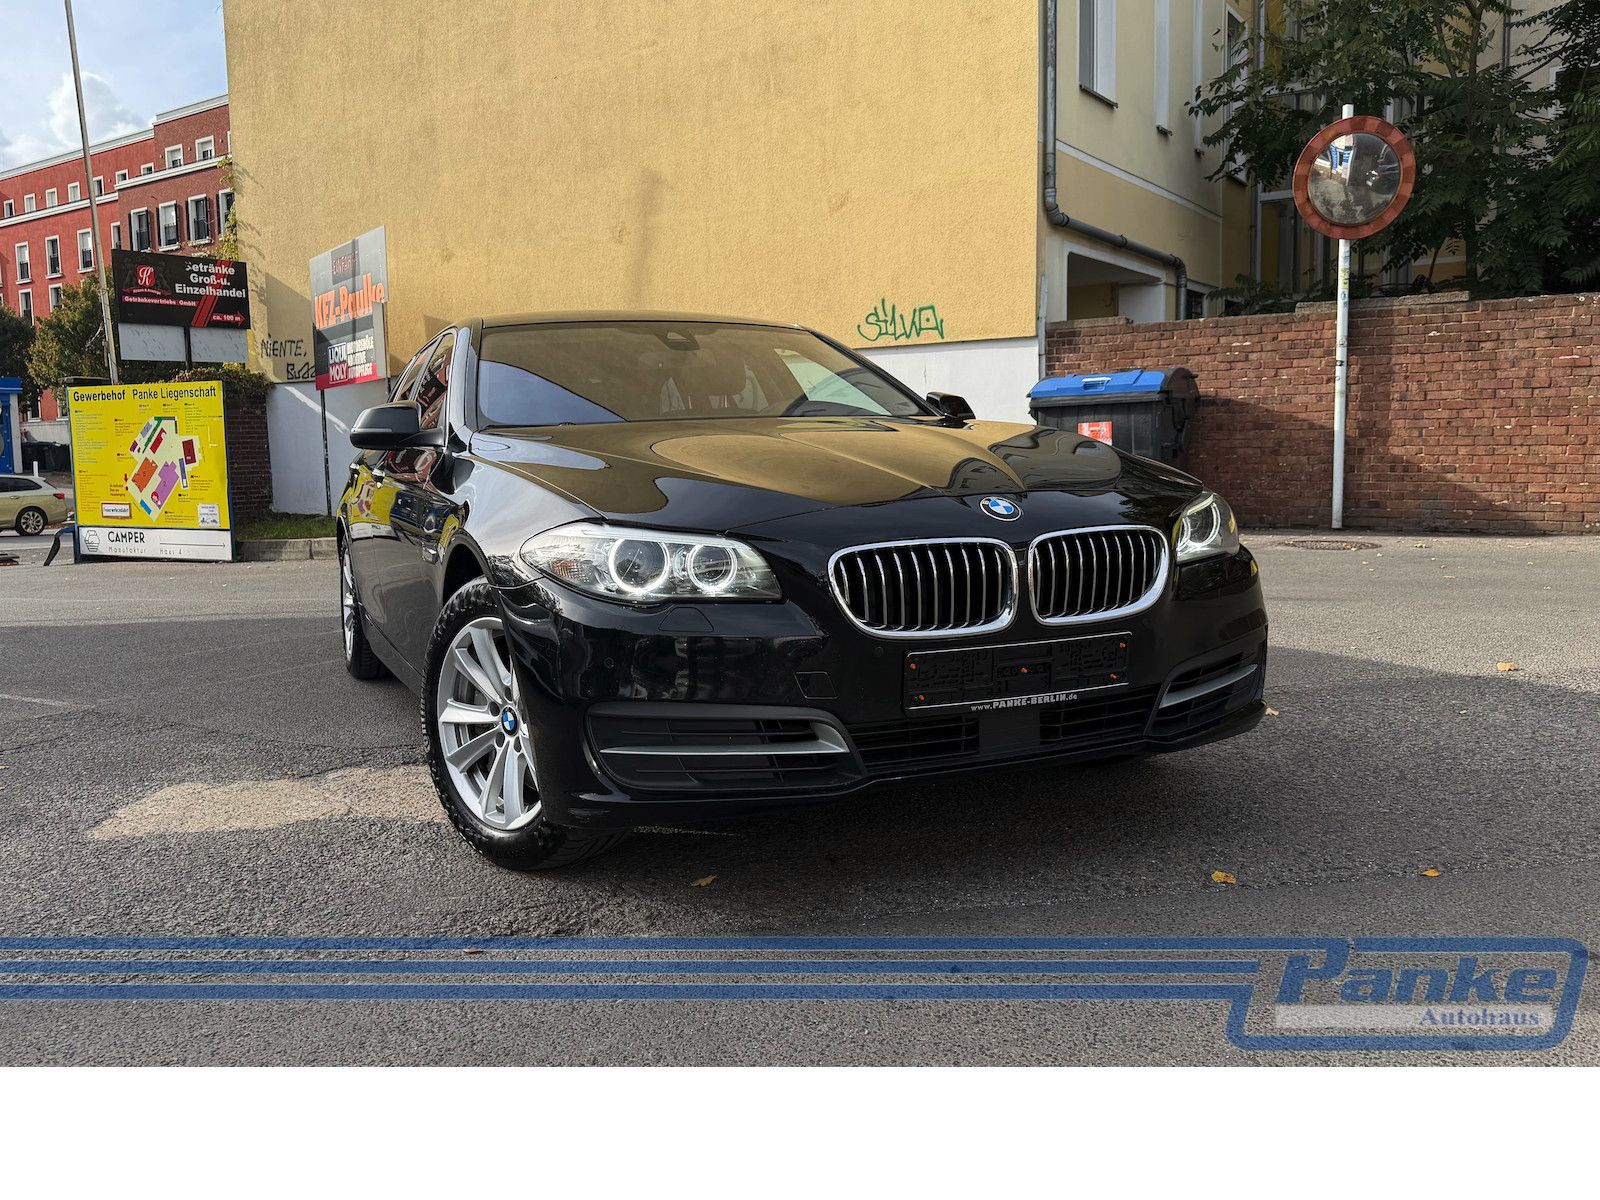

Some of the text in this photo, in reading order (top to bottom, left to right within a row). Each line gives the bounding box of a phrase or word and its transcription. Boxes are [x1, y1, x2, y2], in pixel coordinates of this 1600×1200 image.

[175, 283, 246, 298] Einzelhandel
[178, 299, 197, 307] GmbH
[328, 344, 347, 363] LIQUI
[329, 362, 347, 382] MOLY
[73, 385, 217, 402] Gewerbehof Panke Liegenschaft
[107, 530, 146, 544] CAMPER
[970, 692, 1078, 712] www.PANKE-BERLIN.de
